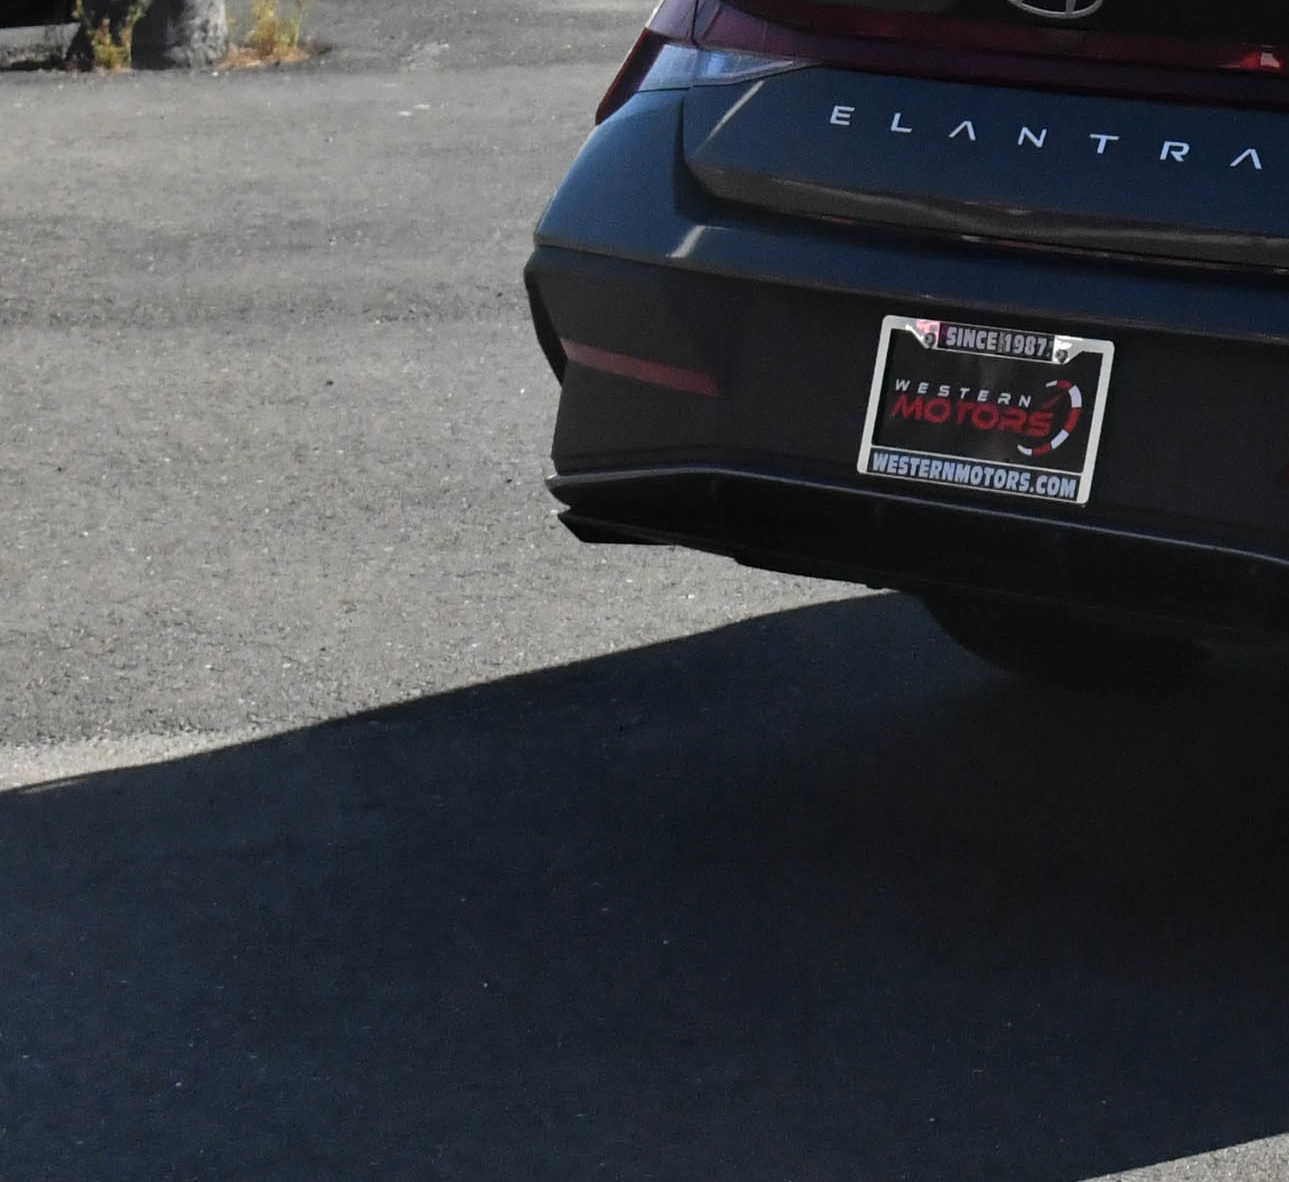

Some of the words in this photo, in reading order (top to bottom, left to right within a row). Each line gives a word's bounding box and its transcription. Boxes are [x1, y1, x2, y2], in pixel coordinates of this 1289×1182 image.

[829, 105, 1264, 170] ELANTRA
[945, 326, 998, 351] SINCE
[1005, 333, 1049, 357] 1987
[895, 379, 1033, 408] WESTERN
[890, 394, 1056, 438] MOTORS
[872, 452, 1077, 499] WESTERNMOTORS.COM
